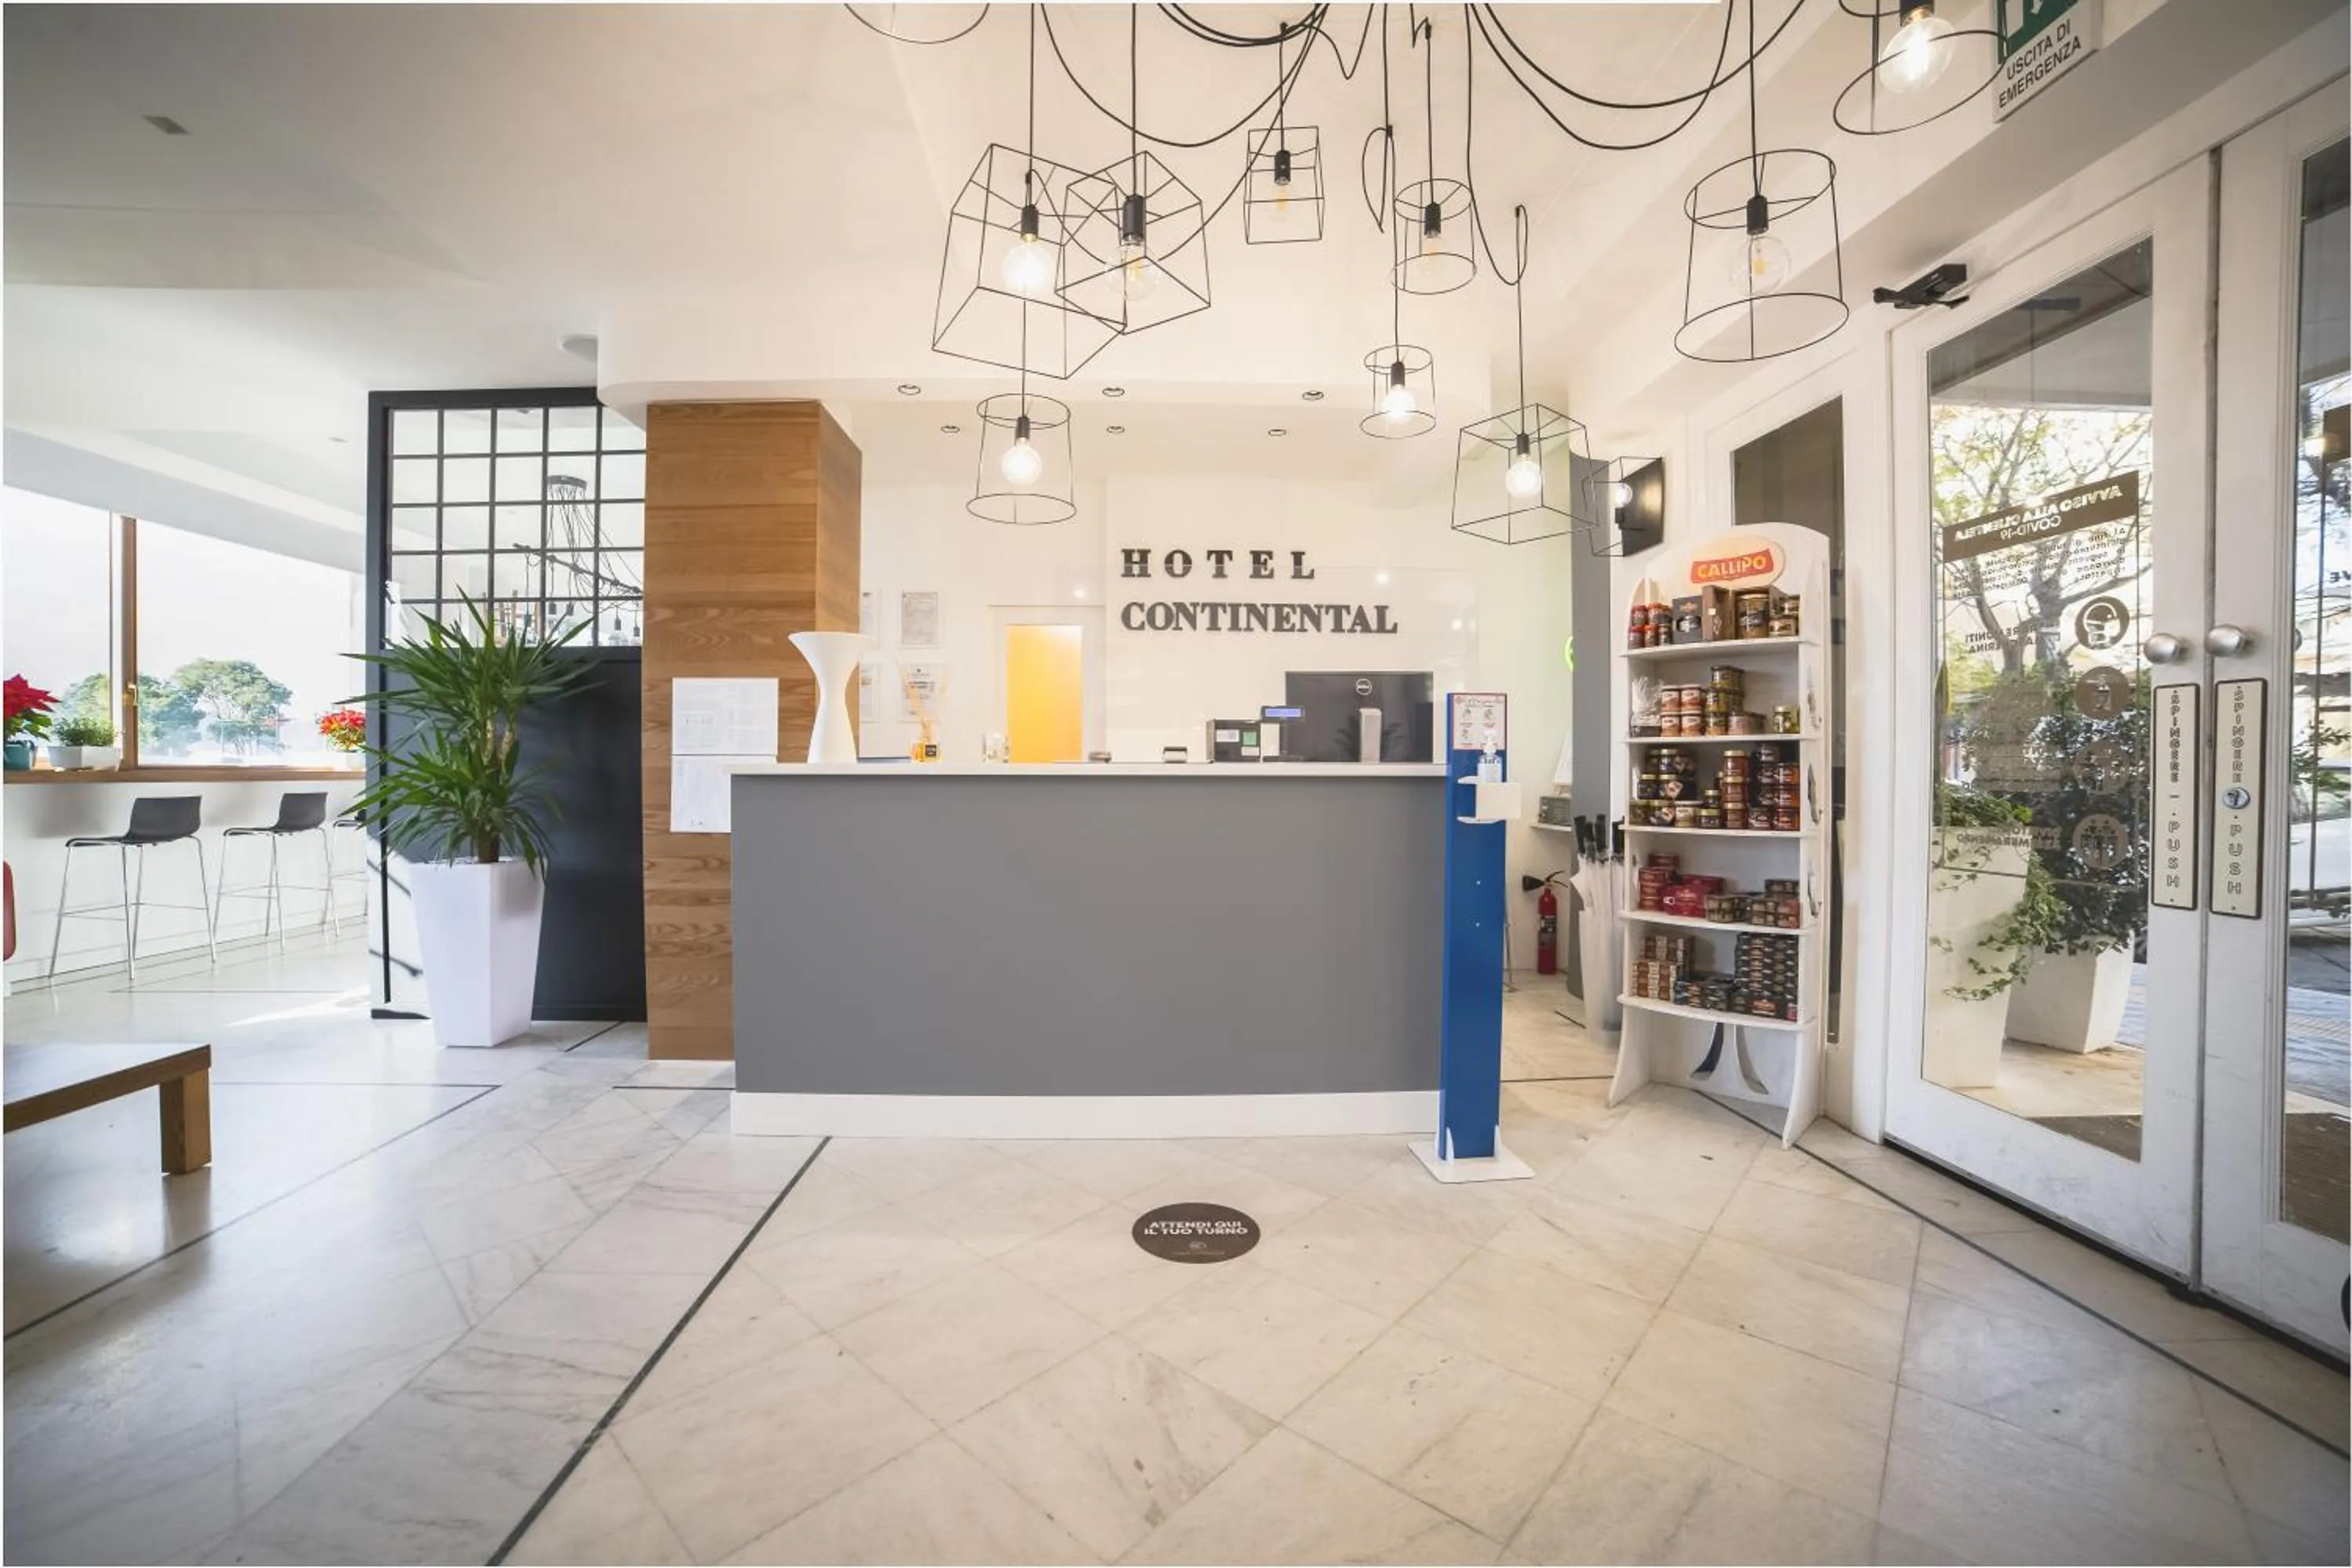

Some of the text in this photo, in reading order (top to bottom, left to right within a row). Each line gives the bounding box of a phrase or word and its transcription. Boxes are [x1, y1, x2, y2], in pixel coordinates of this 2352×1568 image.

[1998, 35, 2082, 108] EMERGENZA
[2007, 18, 2070, 80] USCITA DI
[1120, 548, 1316, 579] HOTEL
[1697, 554, 1766, 578] CALLIPO
[1120, 601, 1399, 634] CONTINENTAL
[2166, 821, 2180, 888] PUSH
[2227, 824, 2243, 895] PUSH
